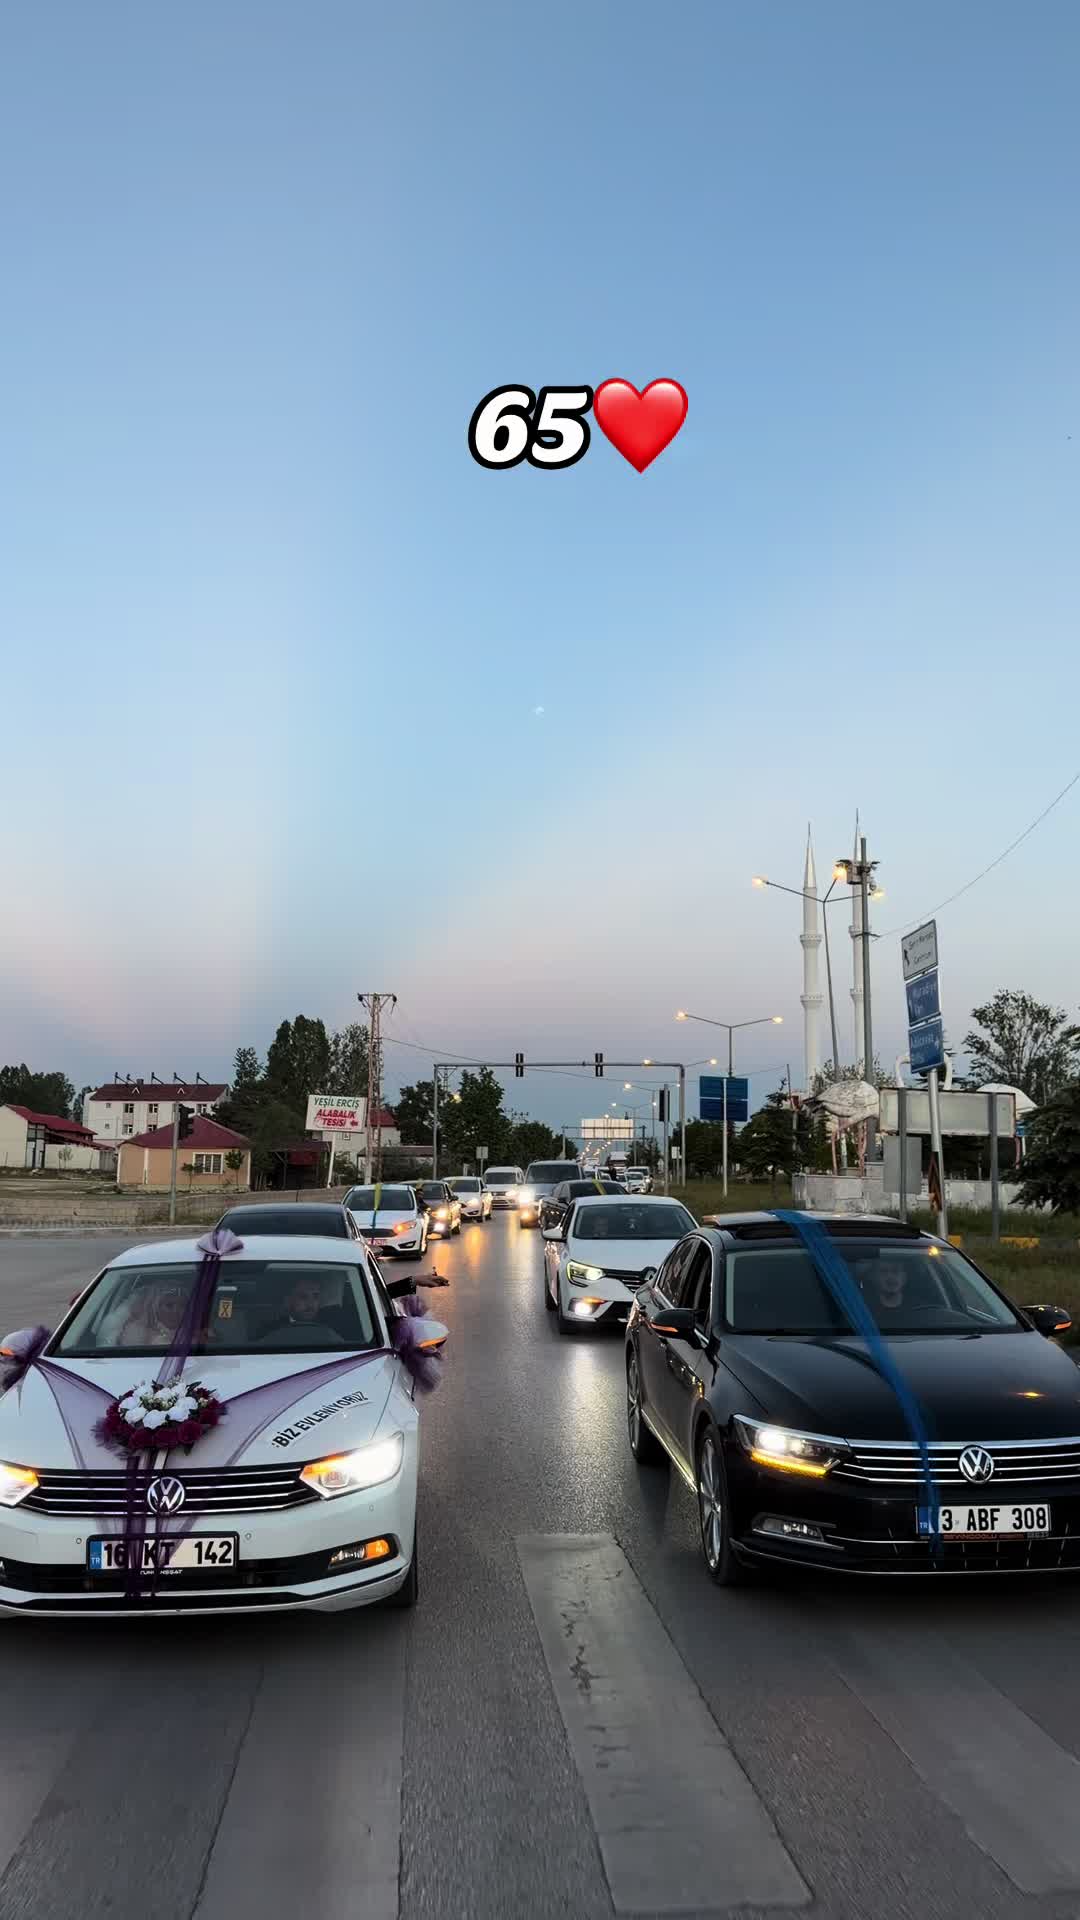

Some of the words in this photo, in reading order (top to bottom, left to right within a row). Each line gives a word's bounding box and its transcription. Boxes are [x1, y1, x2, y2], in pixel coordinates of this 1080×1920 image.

[316, 1109, 357, 1119] ALABALIK
[966, 1508, 1001, 1531] ABF
[1011, 1507, 1047, 1530] 308
[104, 1542, 129, 1568] 16
[194, 1540, 232, 1565] 142
